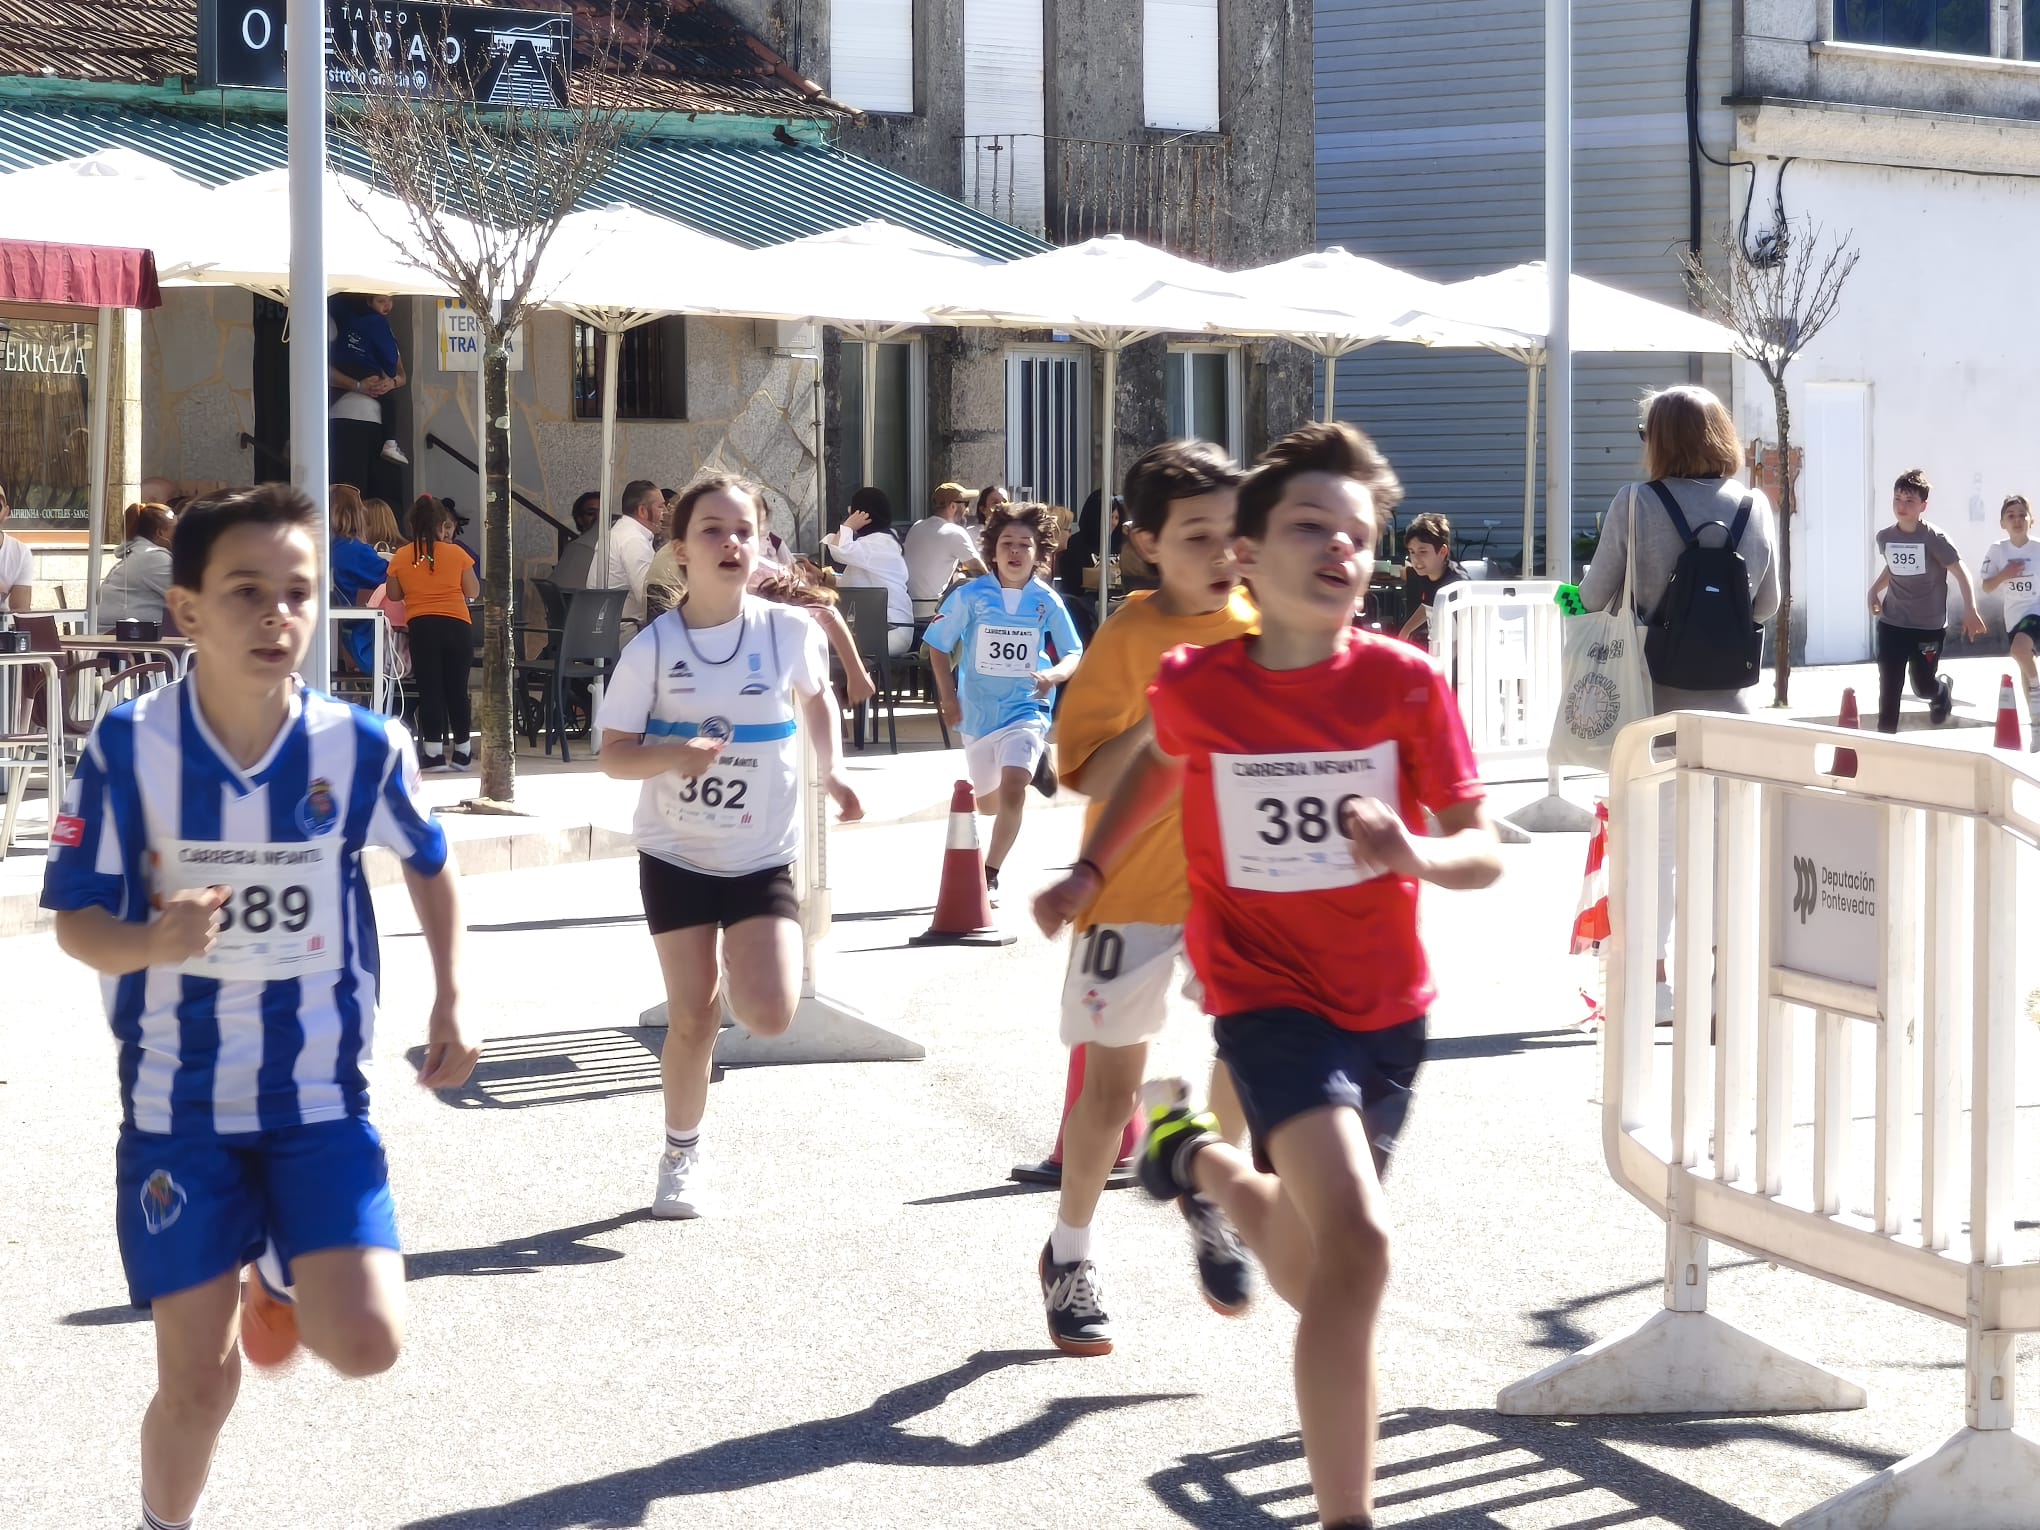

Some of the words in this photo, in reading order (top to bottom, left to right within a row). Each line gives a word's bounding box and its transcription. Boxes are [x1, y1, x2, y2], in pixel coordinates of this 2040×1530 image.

[341, 6, 407, 24] TAPEO
[242, 9, 271, 50] O
[284, 24, 460, 64] EIRAO
[0, 339, 87, 375] ERRAZA
[1892, 553, 1916, 565] 395
[2008, 581, 2033, 592] 369
[989, 642, 1028, 661] 360
[679, 775, 748, 809] 362
[1821, 866, 1875, 893] Deputación
[1821, 890, 1875, 917] Pontevedra
[1081, 923, 1126, 981] 10
